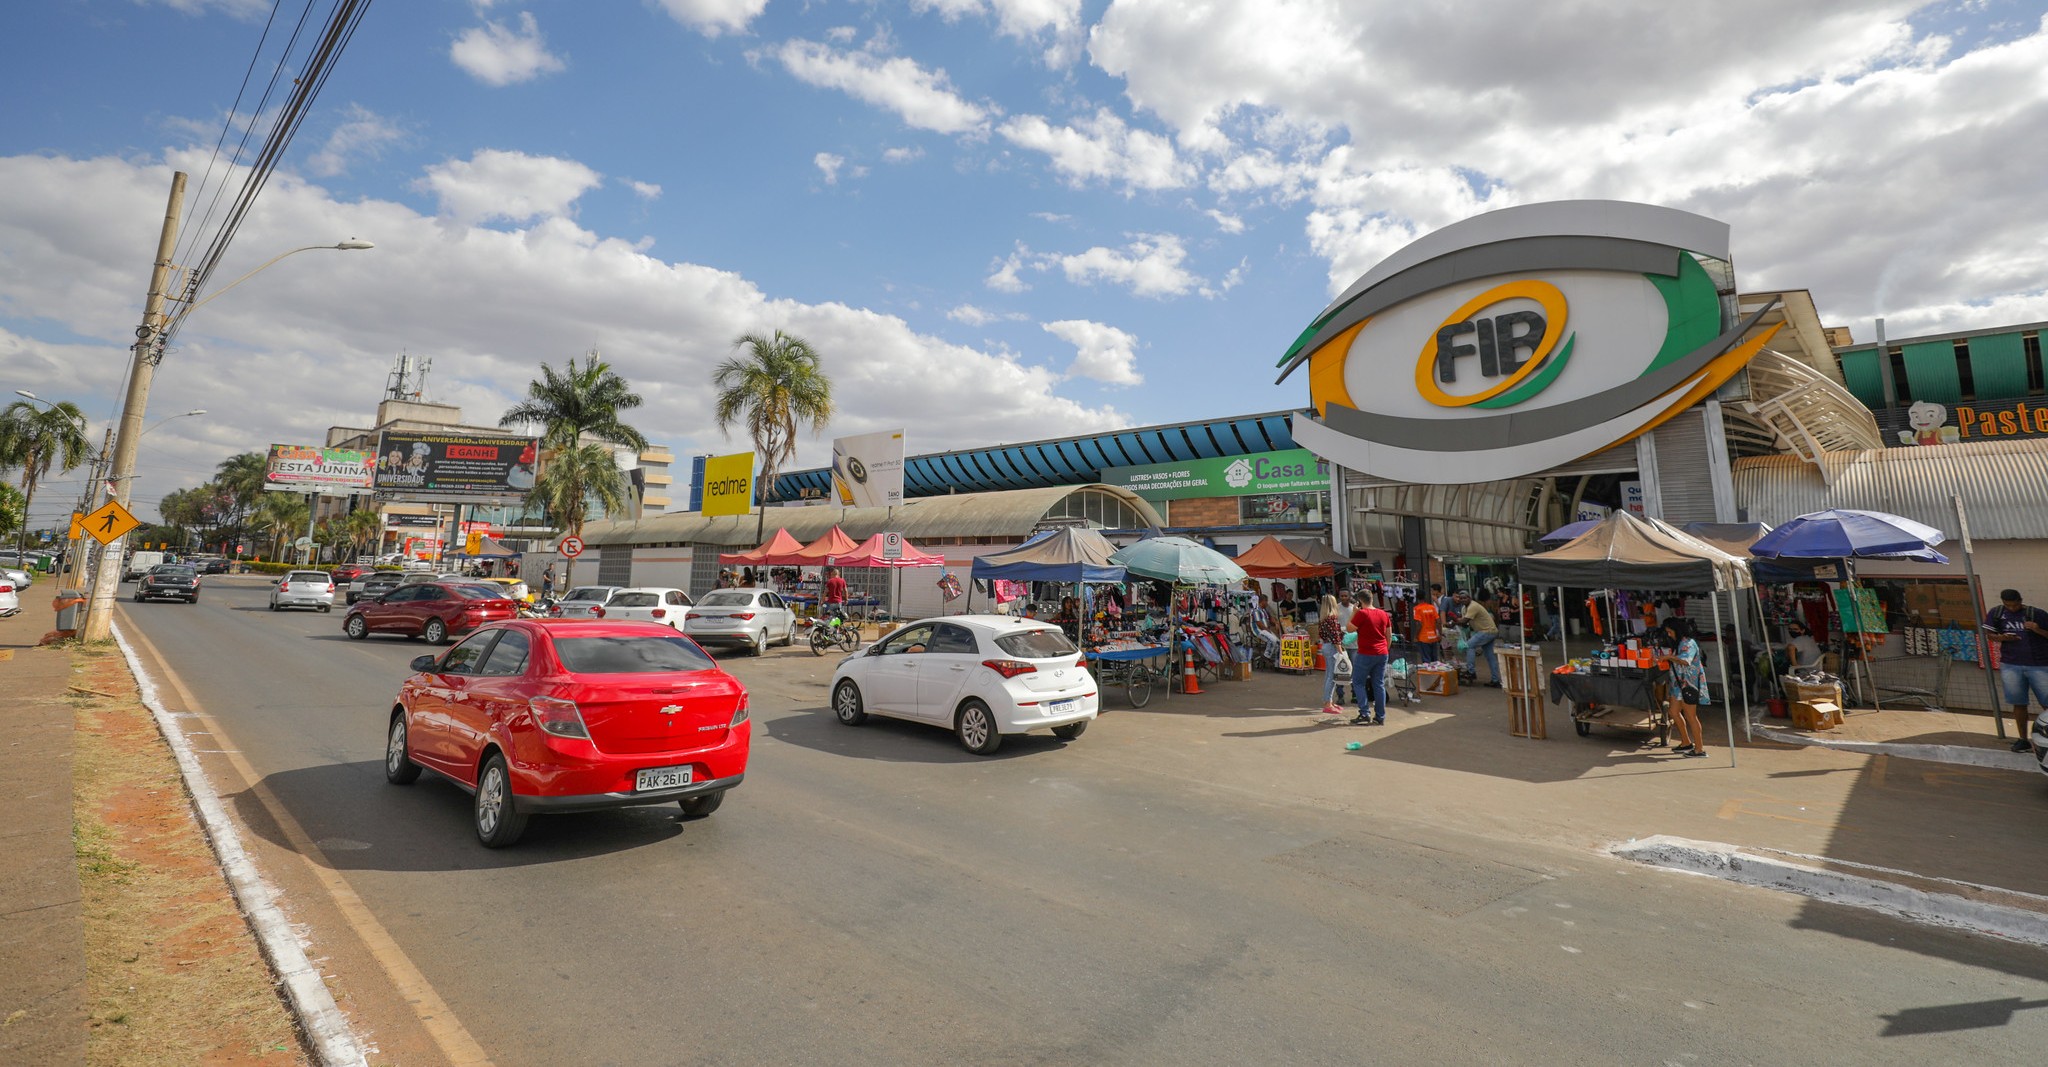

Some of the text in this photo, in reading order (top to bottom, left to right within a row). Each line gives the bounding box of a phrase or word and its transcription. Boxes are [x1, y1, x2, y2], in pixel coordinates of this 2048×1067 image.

[1436, 310, 1551, 383] FIB
[1956, 402, 2048, 438] Paste
[422, 435, 472, 444] ANIVERSÁRIO
[478, 438, 529, 446] UNIVERSIDADE
[277, 446, 316, 460] Casa
[449, 447, 495, 458] E GANHE
[271, 462, 313, 473] FESTA
[316, 464, 368, 476] JUNINA
[1255, 458, 1305, 479] Casa
[377, 473, 425, 485] UNIVERSIDADE
[1130, 470, 1190, 482] LUSTRES VASOS FLORES
[707, 475, 747, 497] realme
[1151, 480, 1182, 489] DECORAÇÕES
[1182, 479, 1191, 487] EM
[567, 540, 577, 553] E
